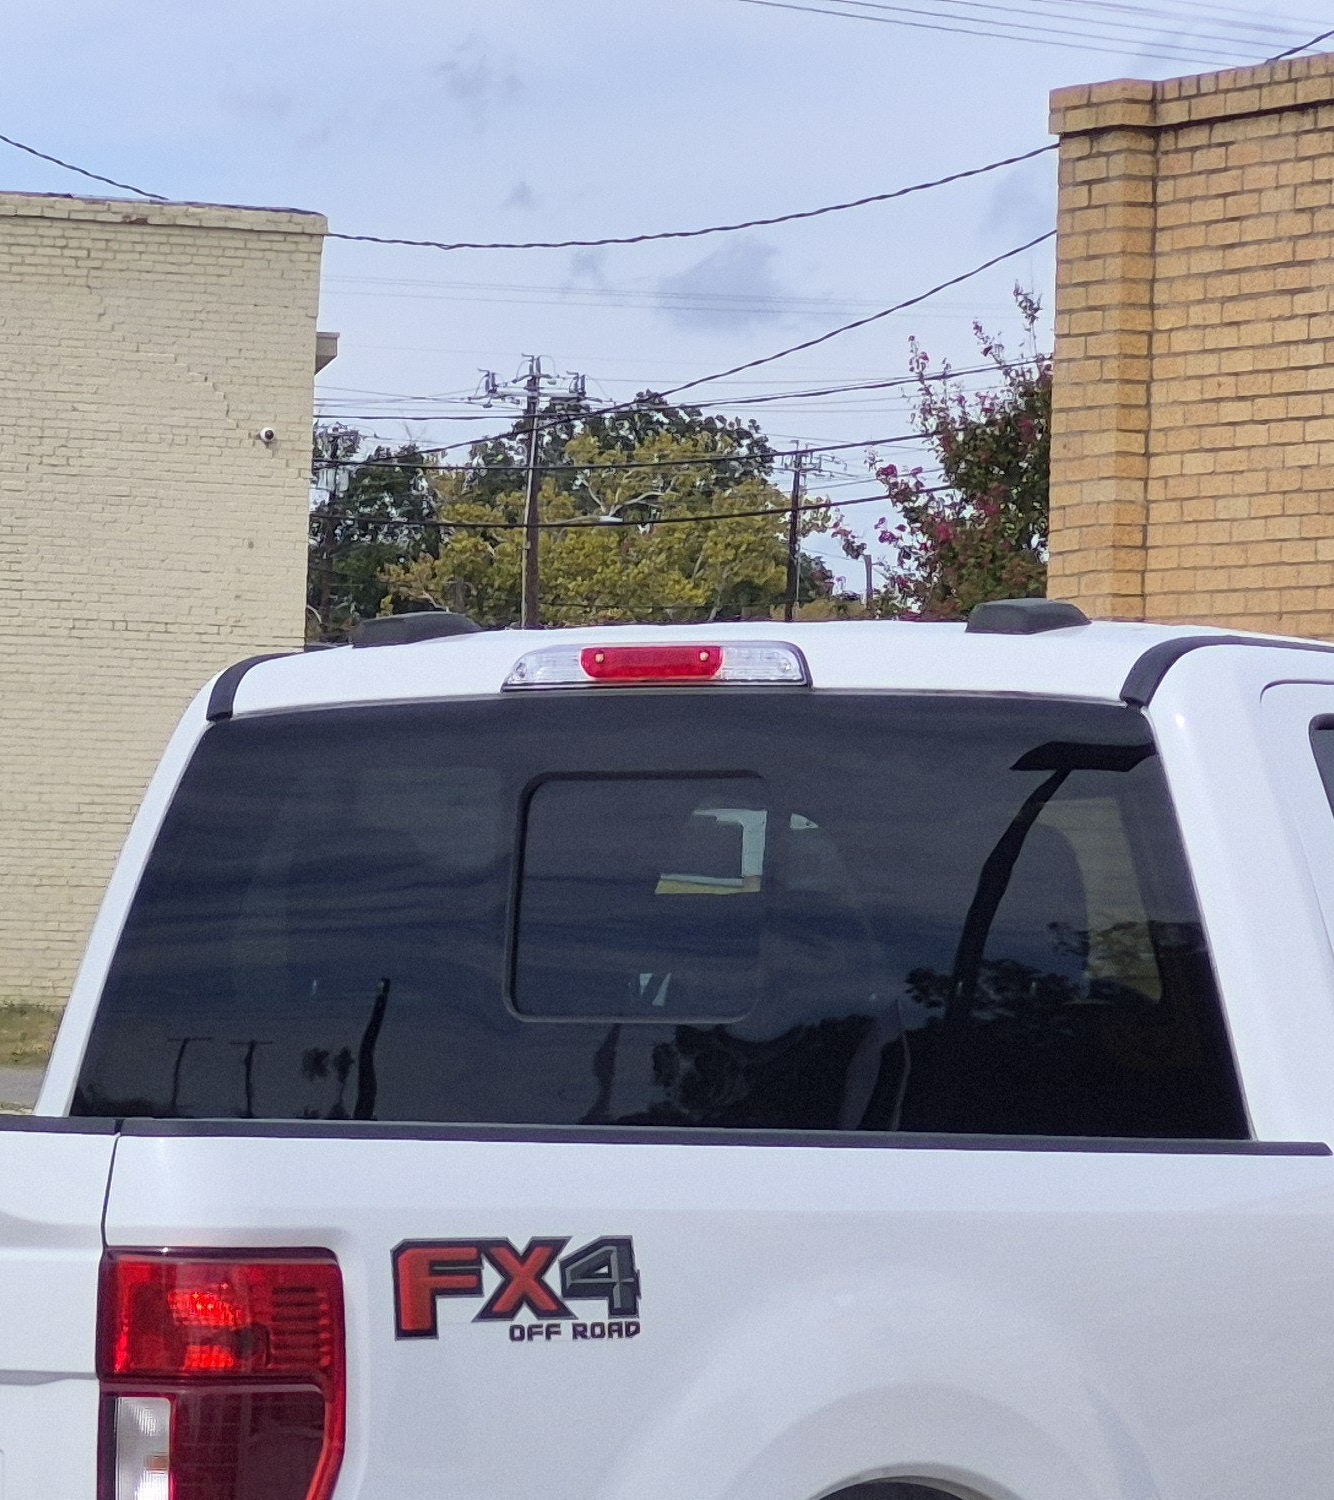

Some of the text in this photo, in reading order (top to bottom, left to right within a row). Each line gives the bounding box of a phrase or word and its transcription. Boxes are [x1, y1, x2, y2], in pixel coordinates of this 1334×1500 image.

[390, 1235, 642, 1341] FX4
[509, 1321, 641, 1342] OFF ROAD
